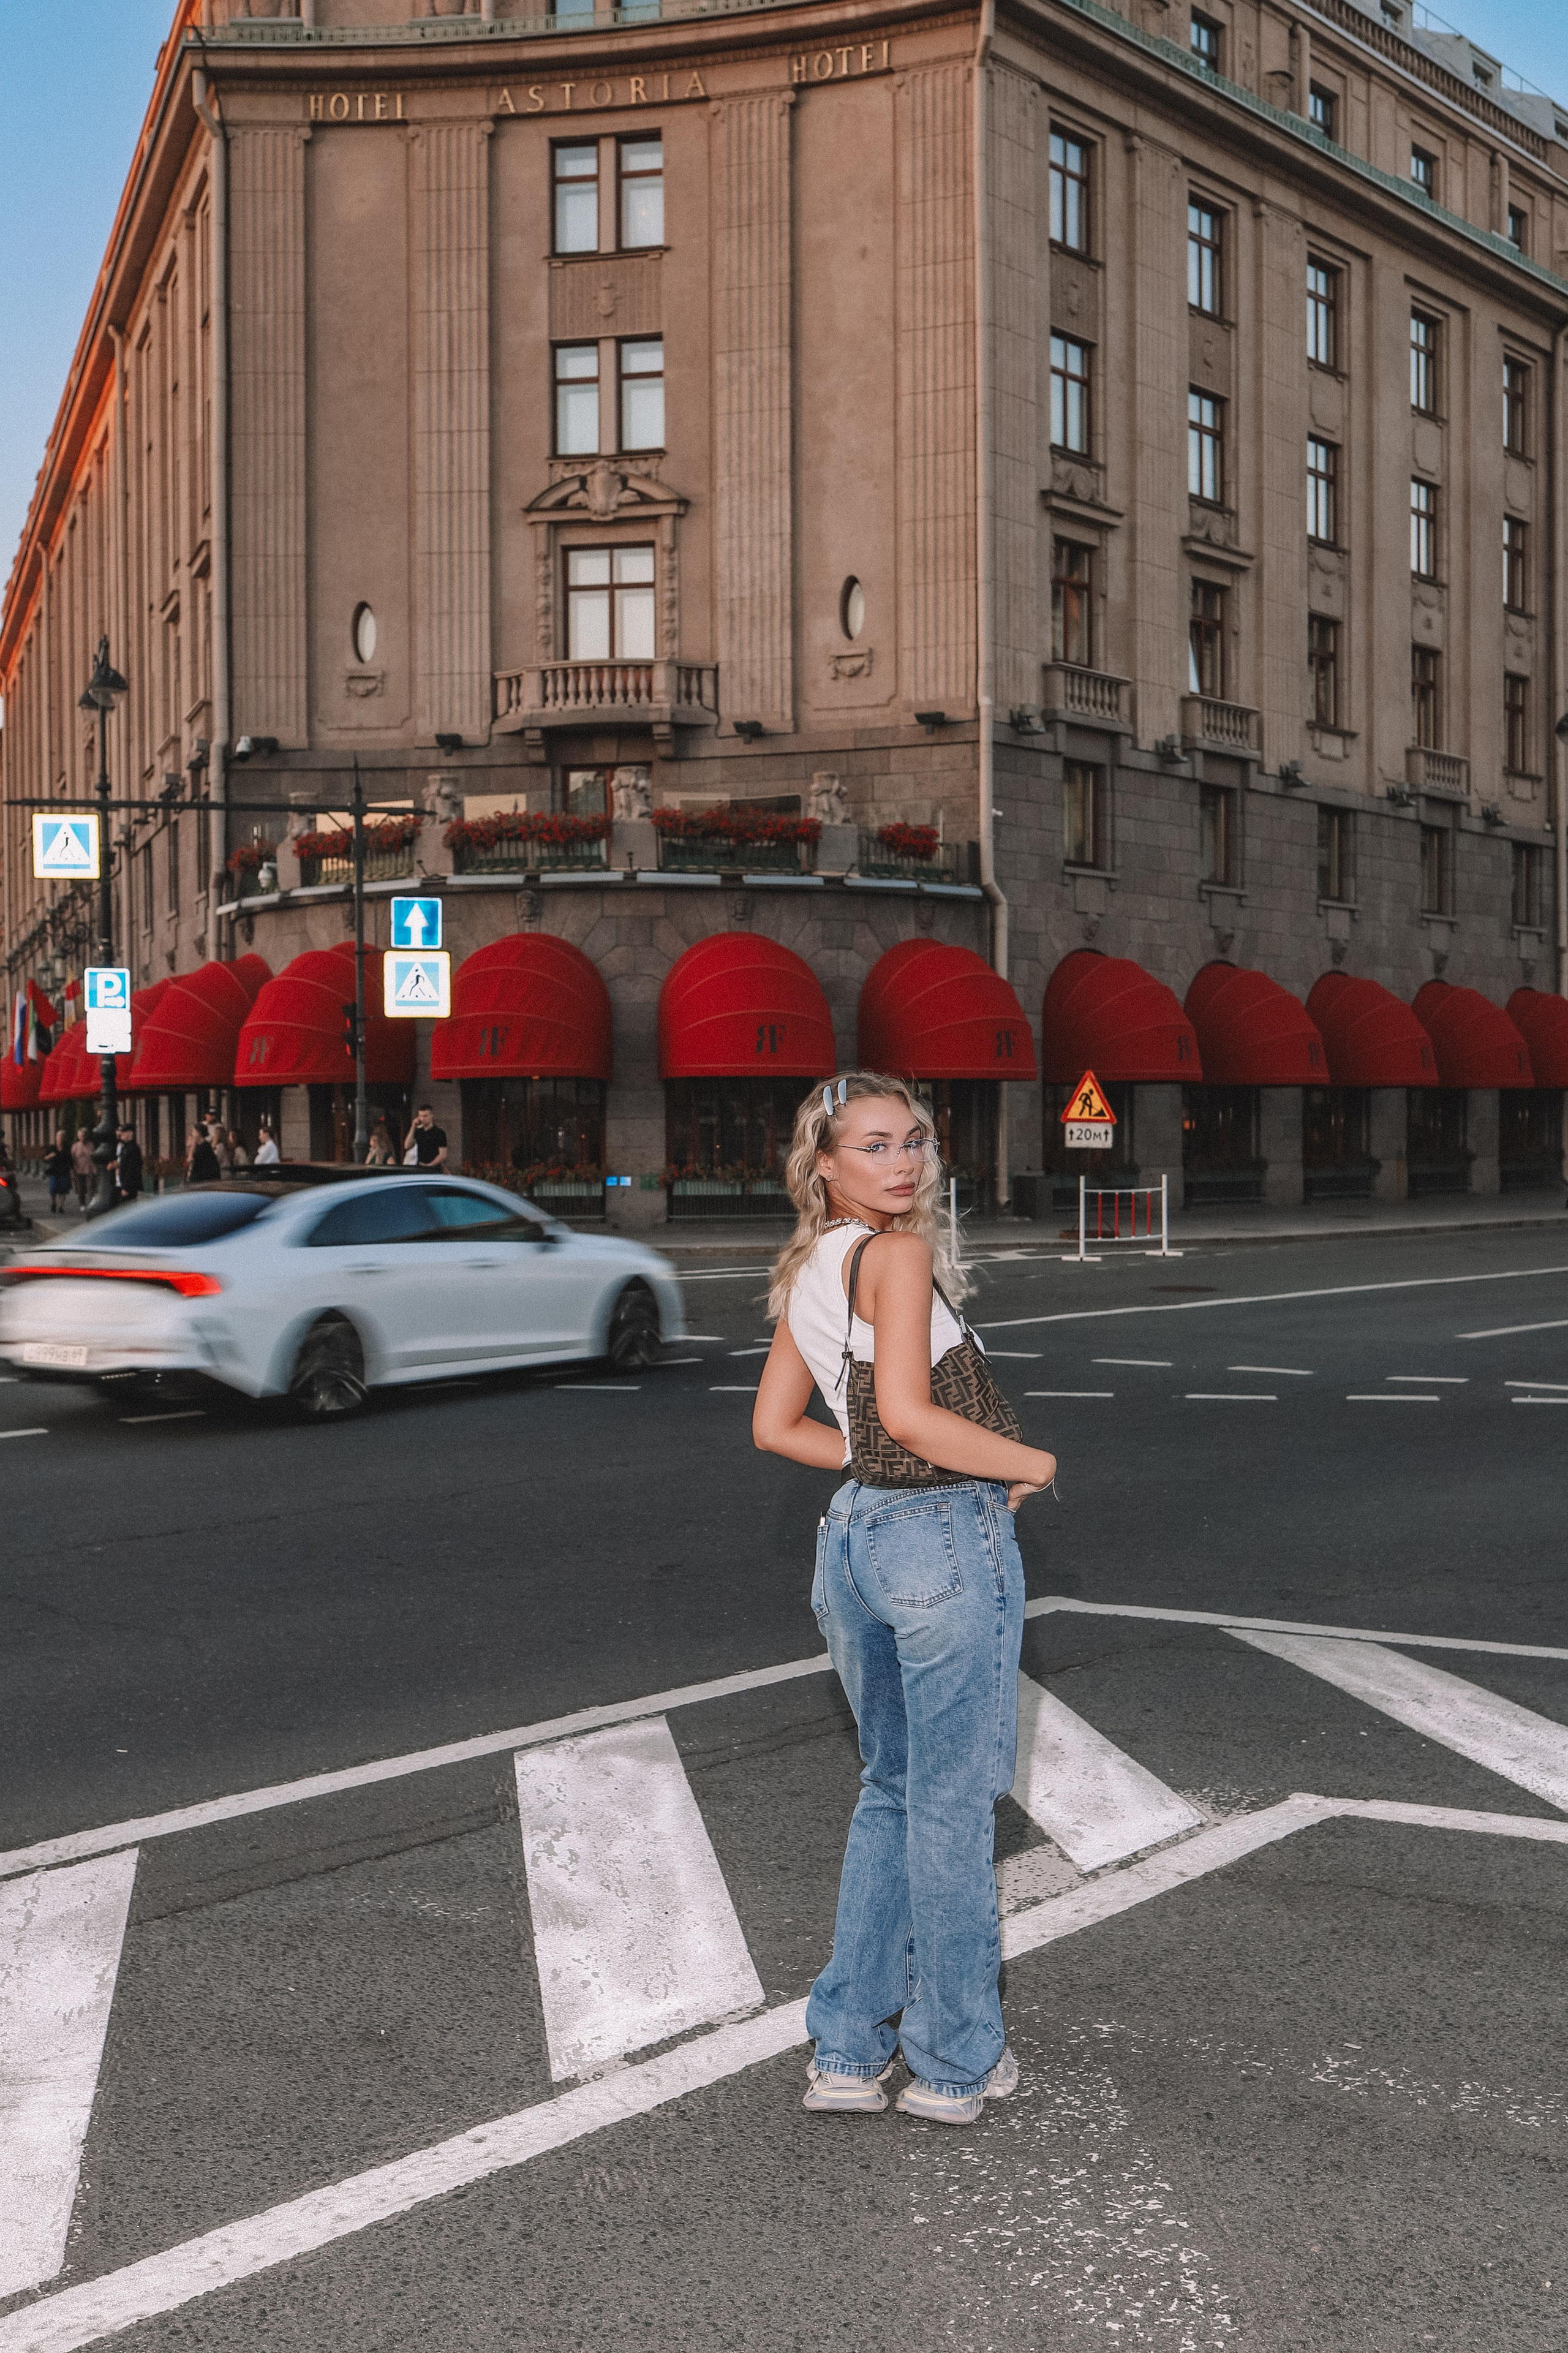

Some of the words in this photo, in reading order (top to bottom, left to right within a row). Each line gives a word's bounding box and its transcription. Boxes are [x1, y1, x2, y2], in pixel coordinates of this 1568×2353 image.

[793, 40, 889, 83] HOTEL
[309, 93, 405, 120] HOTEL
[498, 70, 706, 113] ASTORIA
[97, 973, 123, 1008] P
